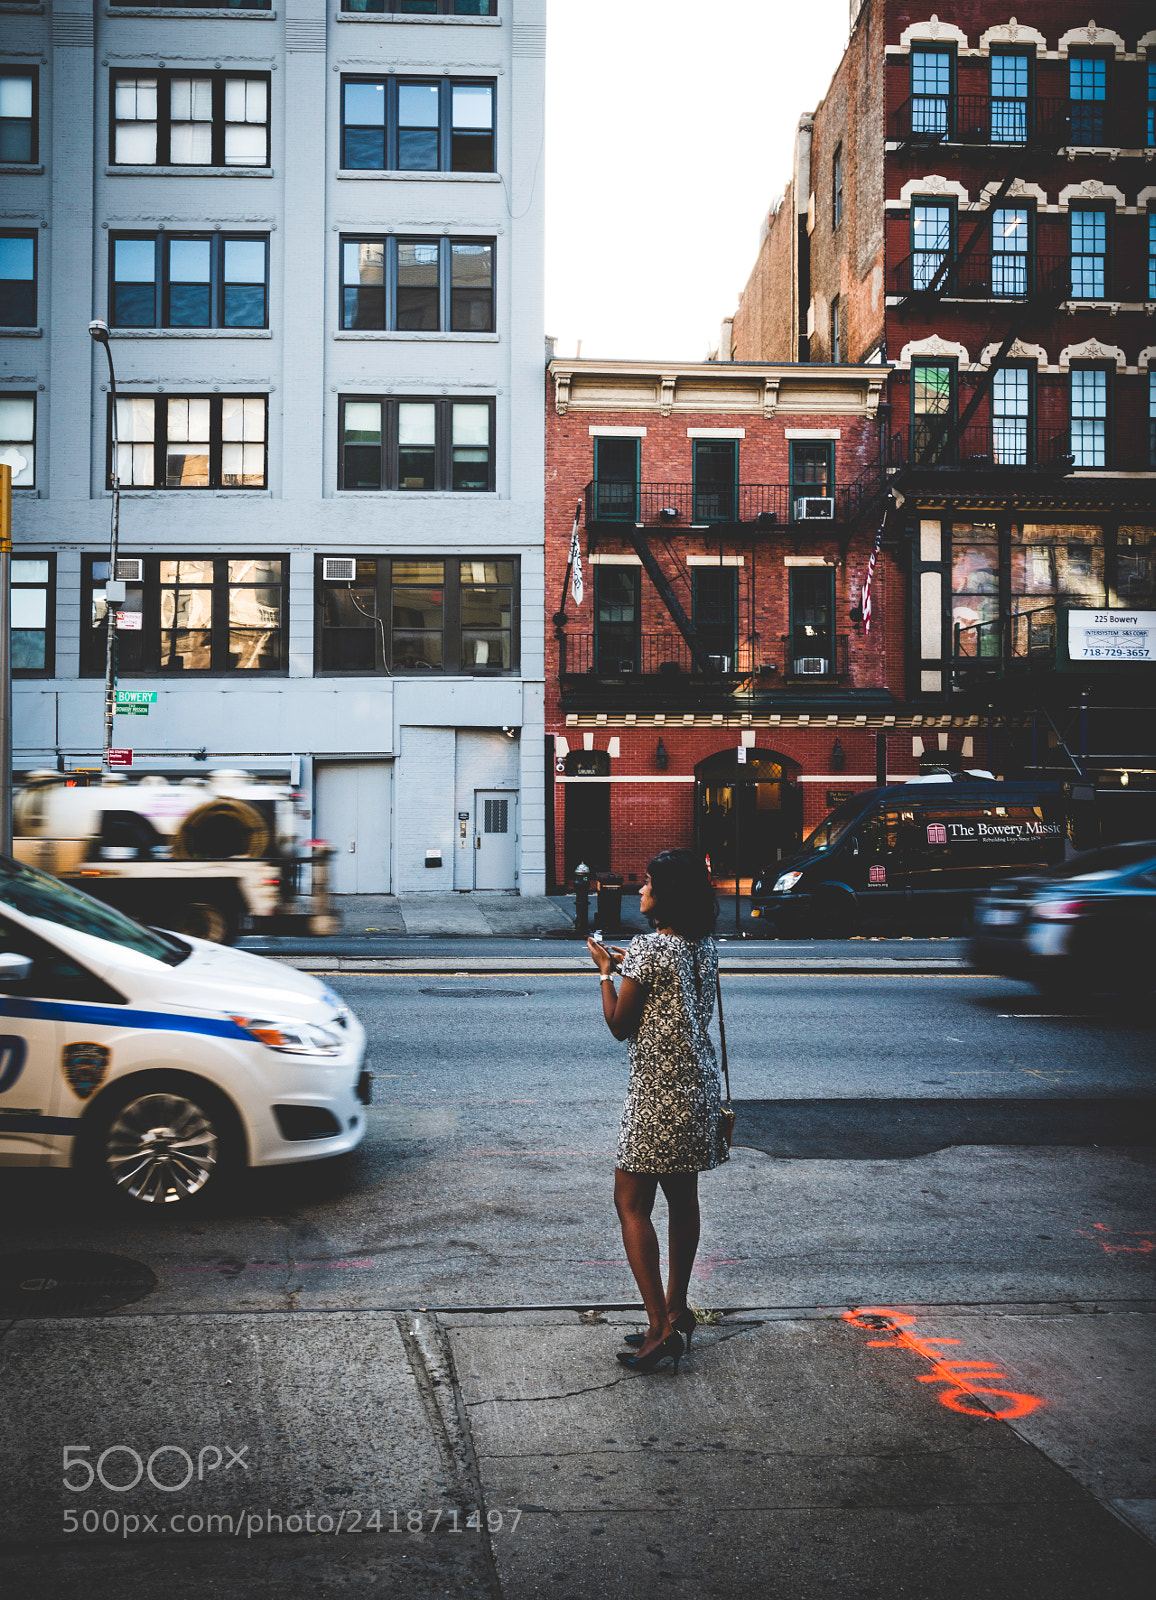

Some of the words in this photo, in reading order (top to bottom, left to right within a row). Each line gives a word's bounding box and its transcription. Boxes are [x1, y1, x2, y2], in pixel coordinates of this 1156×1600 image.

[1094, 615, 1108, 623] 225
[1109, 615, 1138, 625] Bowery
[1083, 648, 1150, 657] 718-729-3657
[118, 691, 154, 702] BOWERY
[948, 823, 975, 836] The
[977, 823, 1023, 839] Bowery
